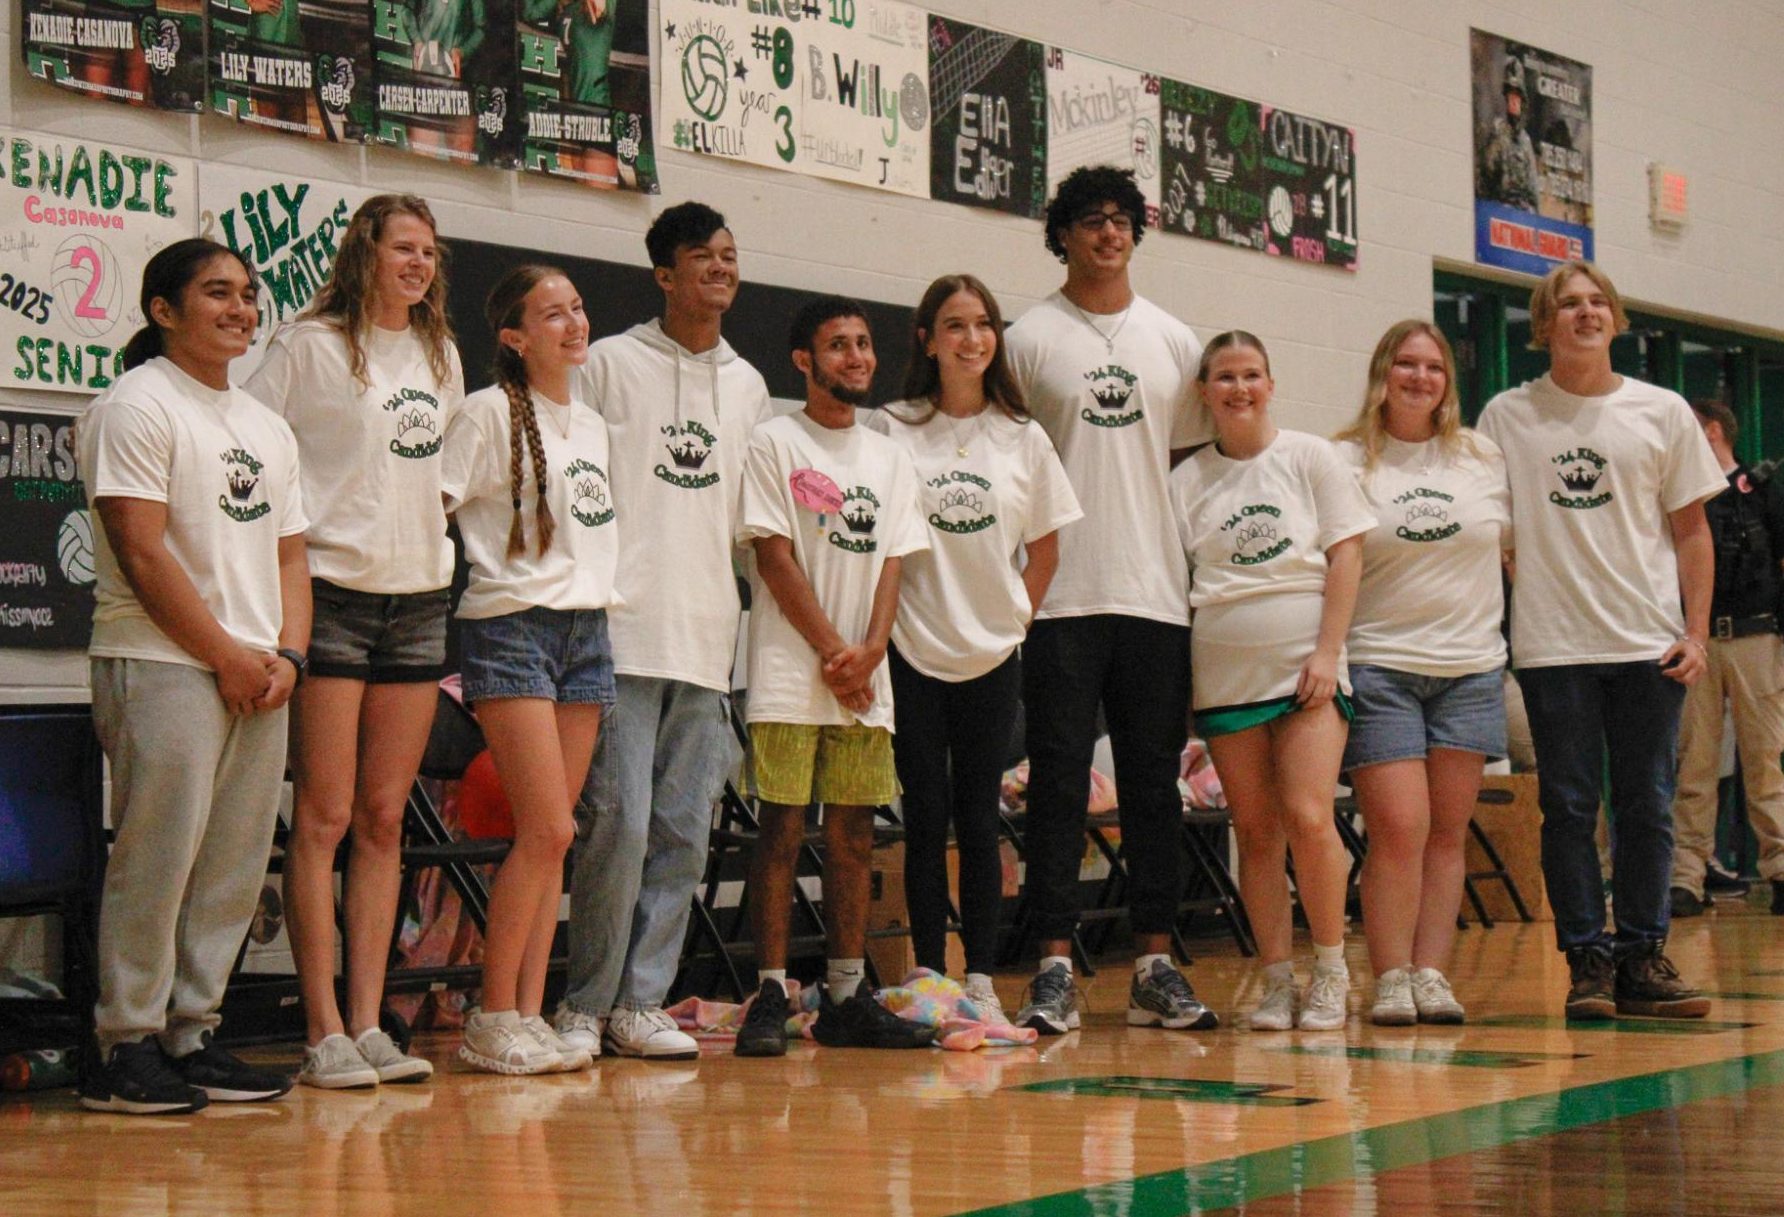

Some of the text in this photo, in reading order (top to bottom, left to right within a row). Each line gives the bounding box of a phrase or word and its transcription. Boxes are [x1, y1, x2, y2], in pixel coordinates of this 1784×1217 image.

[30, 12, 134, 49] KENADIE CASANOVA
[220, 51, 312, 89] LILY WATERS
[751, 25, 794, 90] #8
[379, 84, 470, 116] CARSEN CARPENTER
[528, 112, 611, 142] ADDIE STRUBLE
[773, 105, 796, 163] 3
[1165, 109, 1196, 153] #6
[0, 137, 178, 218] ENADIE
[24, 195, 125, 230] Casanova
[0, 273, 54, 325] 2025
[70, 246, 108, 320] 2
[0, 420, 84, 482] CARS
